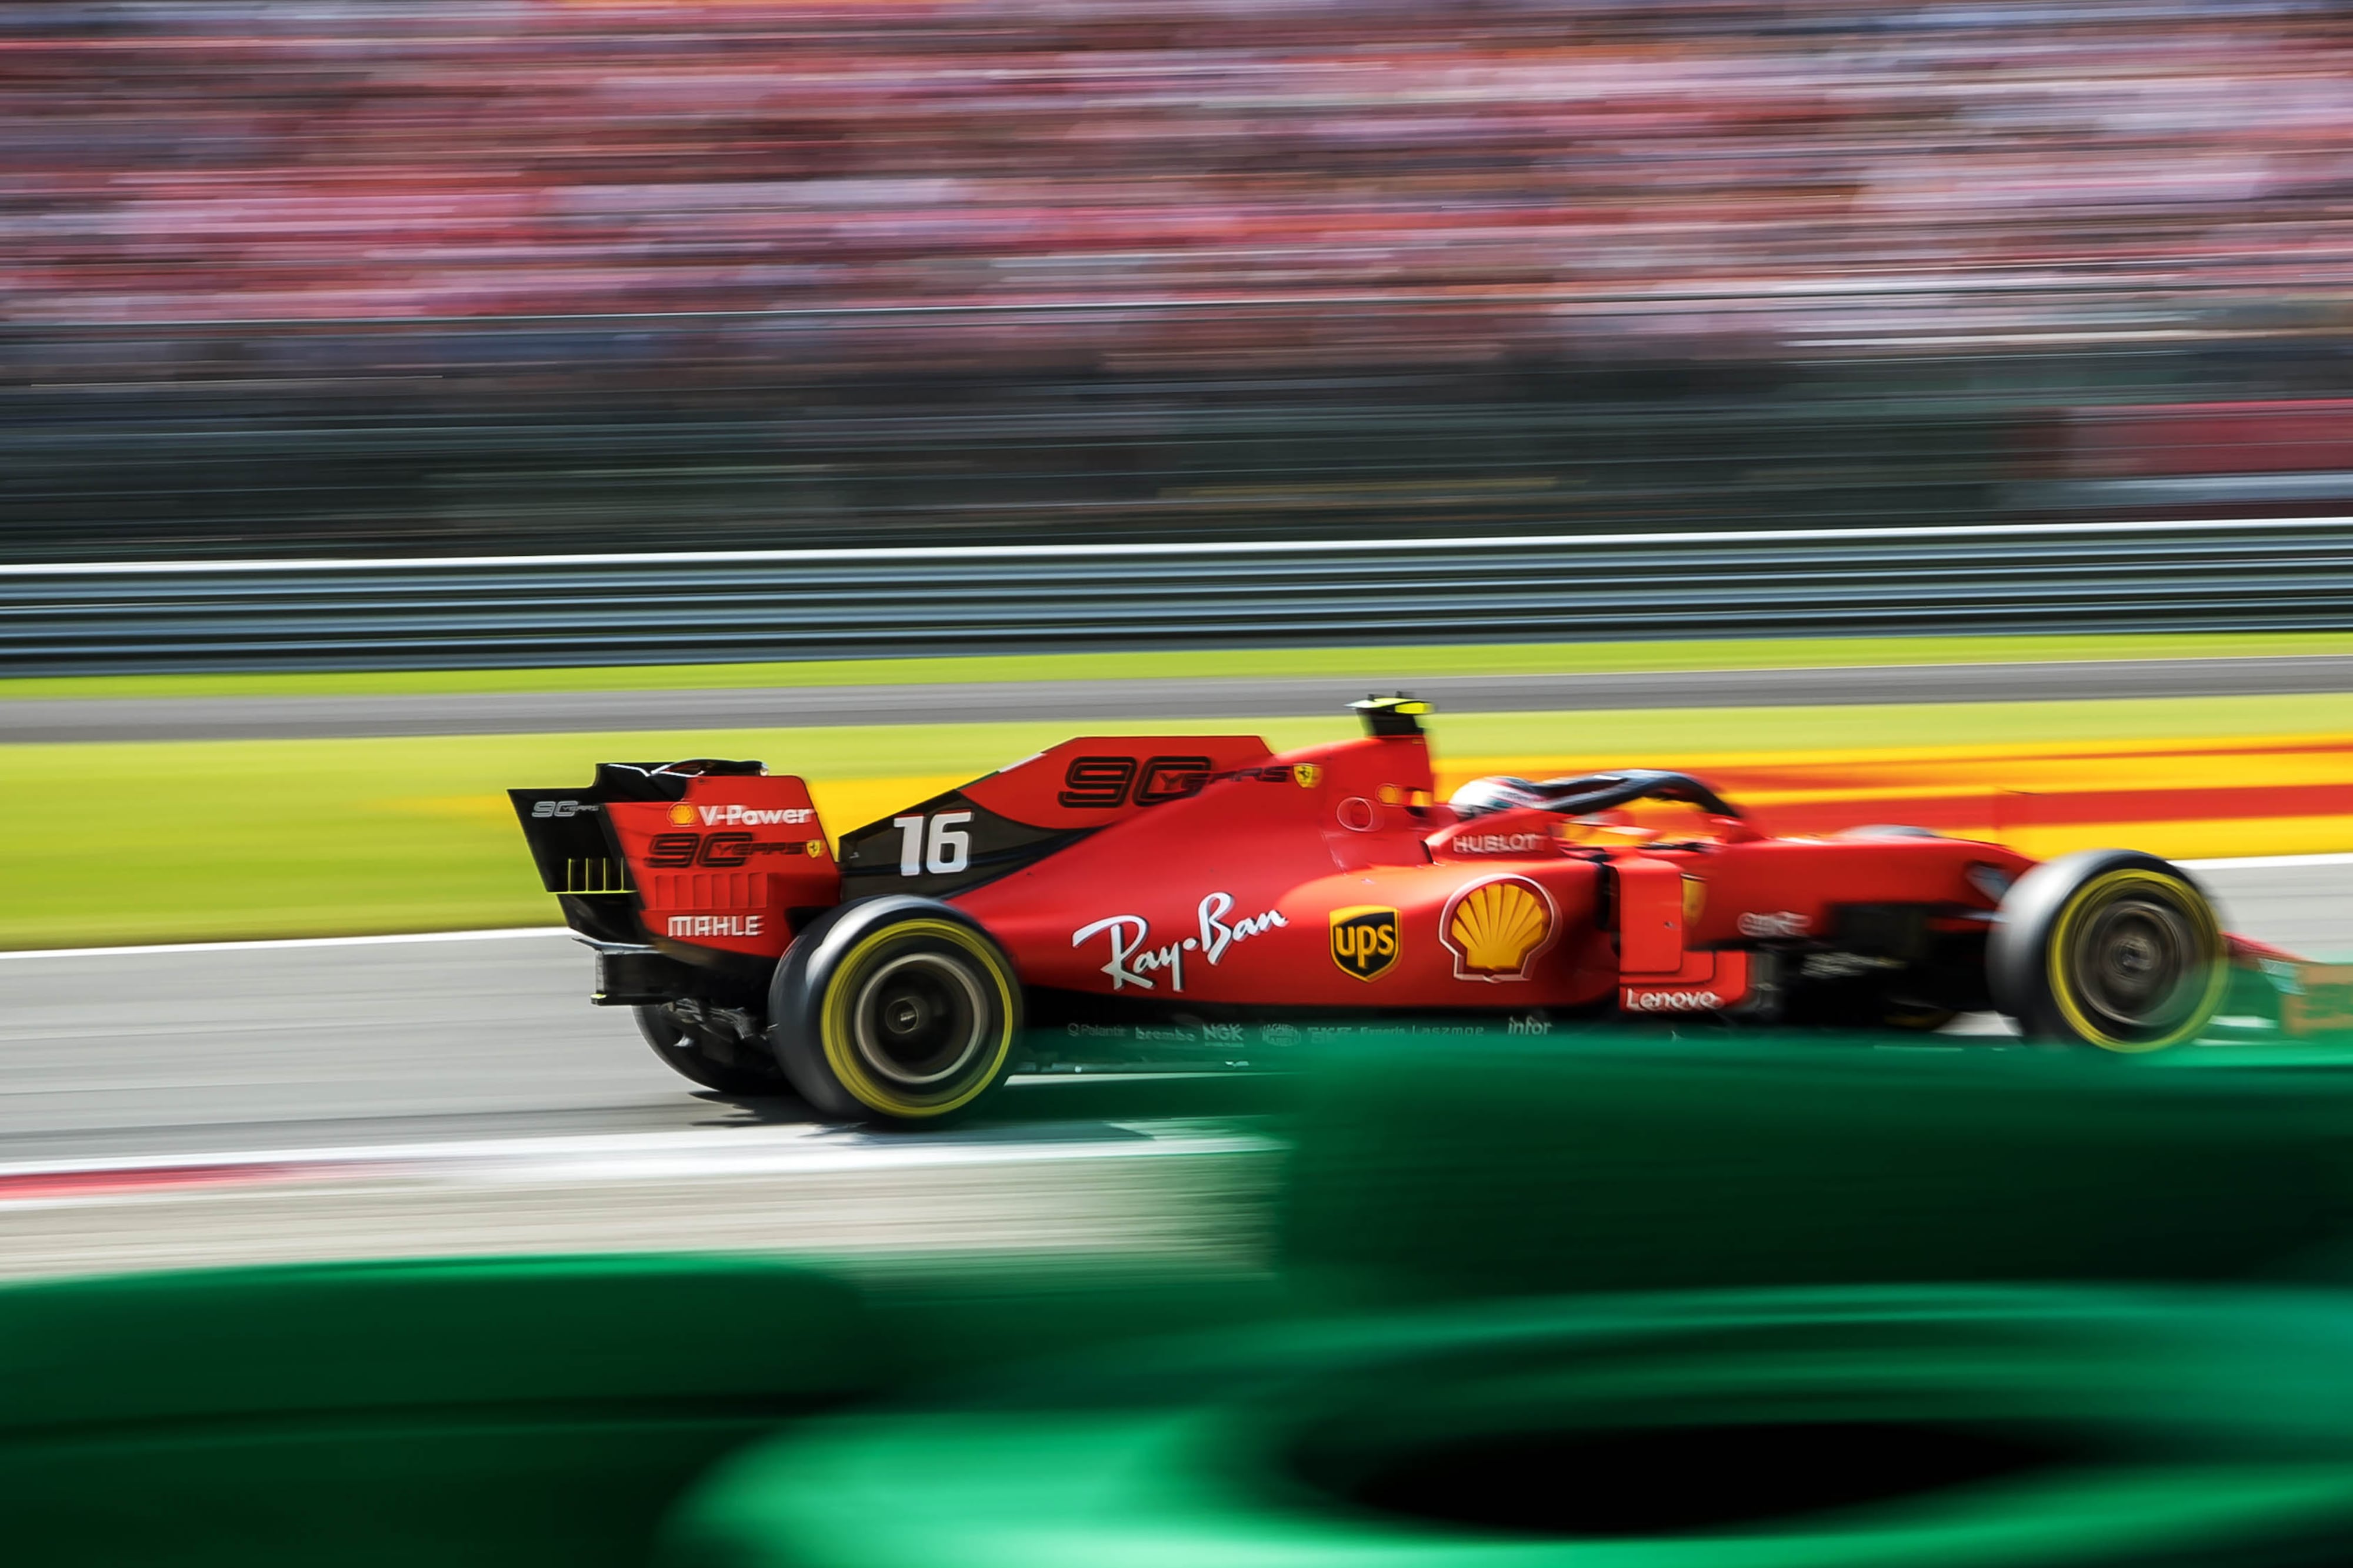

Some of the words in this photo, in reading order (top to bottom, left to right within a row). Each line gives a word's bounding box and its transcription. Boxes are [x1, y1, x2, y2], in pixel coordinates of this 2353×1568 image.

[698, 805, 815, 826] V-Power
[894, 809, 974, 876] 16
[1453, 833, 1546, 853] HUBLOT
[668, 915, 763, 936] MAHLE
[1335, 924, 1394, 968] ups
[1626, 988, 1724, 1010] Lenovo
[1202, 1022, 1244, 1041] NGK
